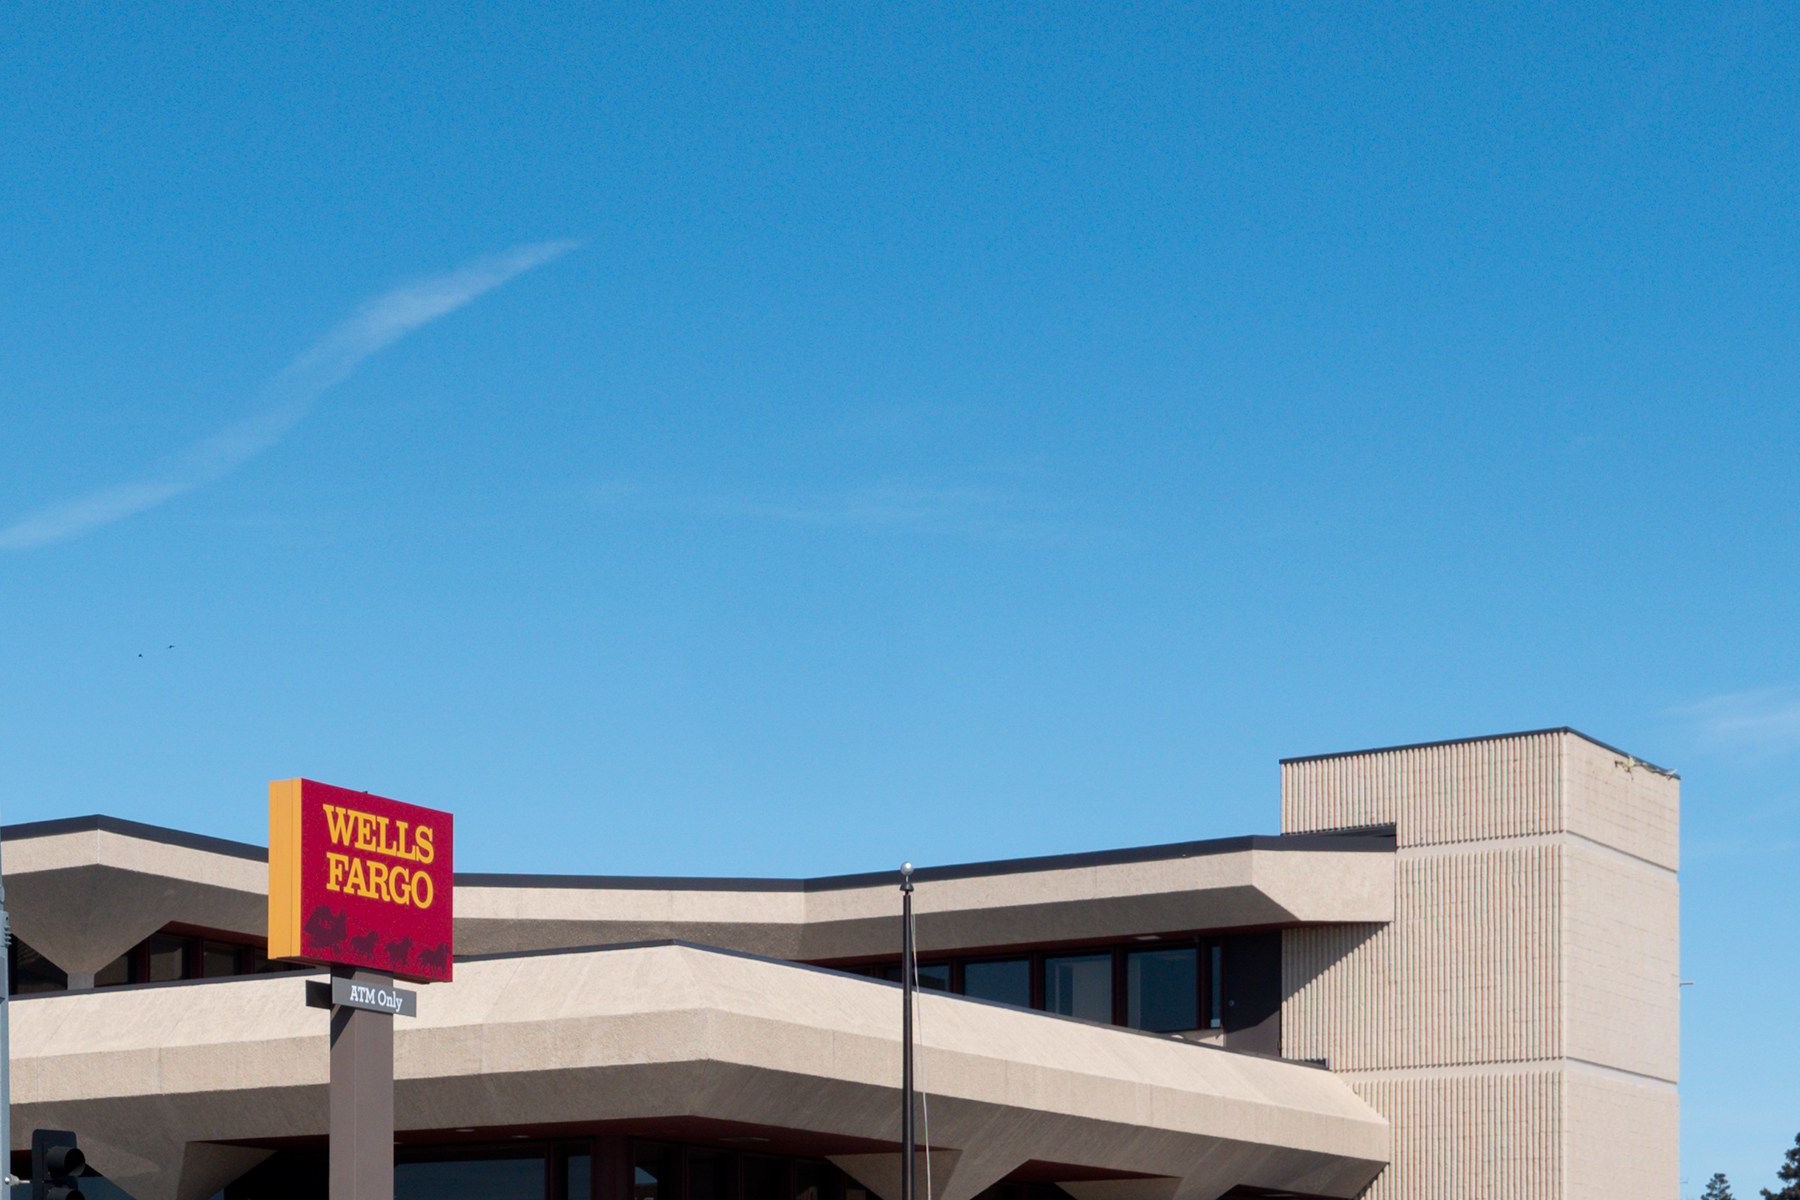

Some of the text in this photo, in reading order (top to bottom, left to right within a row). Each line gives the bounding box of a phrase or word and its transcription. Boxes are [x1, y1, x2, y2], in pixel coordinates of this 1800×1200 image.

[322, 803, 434, 864] WELLS
[326, 851, 434, 909] FARGO
[349, 985, 403, 1012] ATM Only
